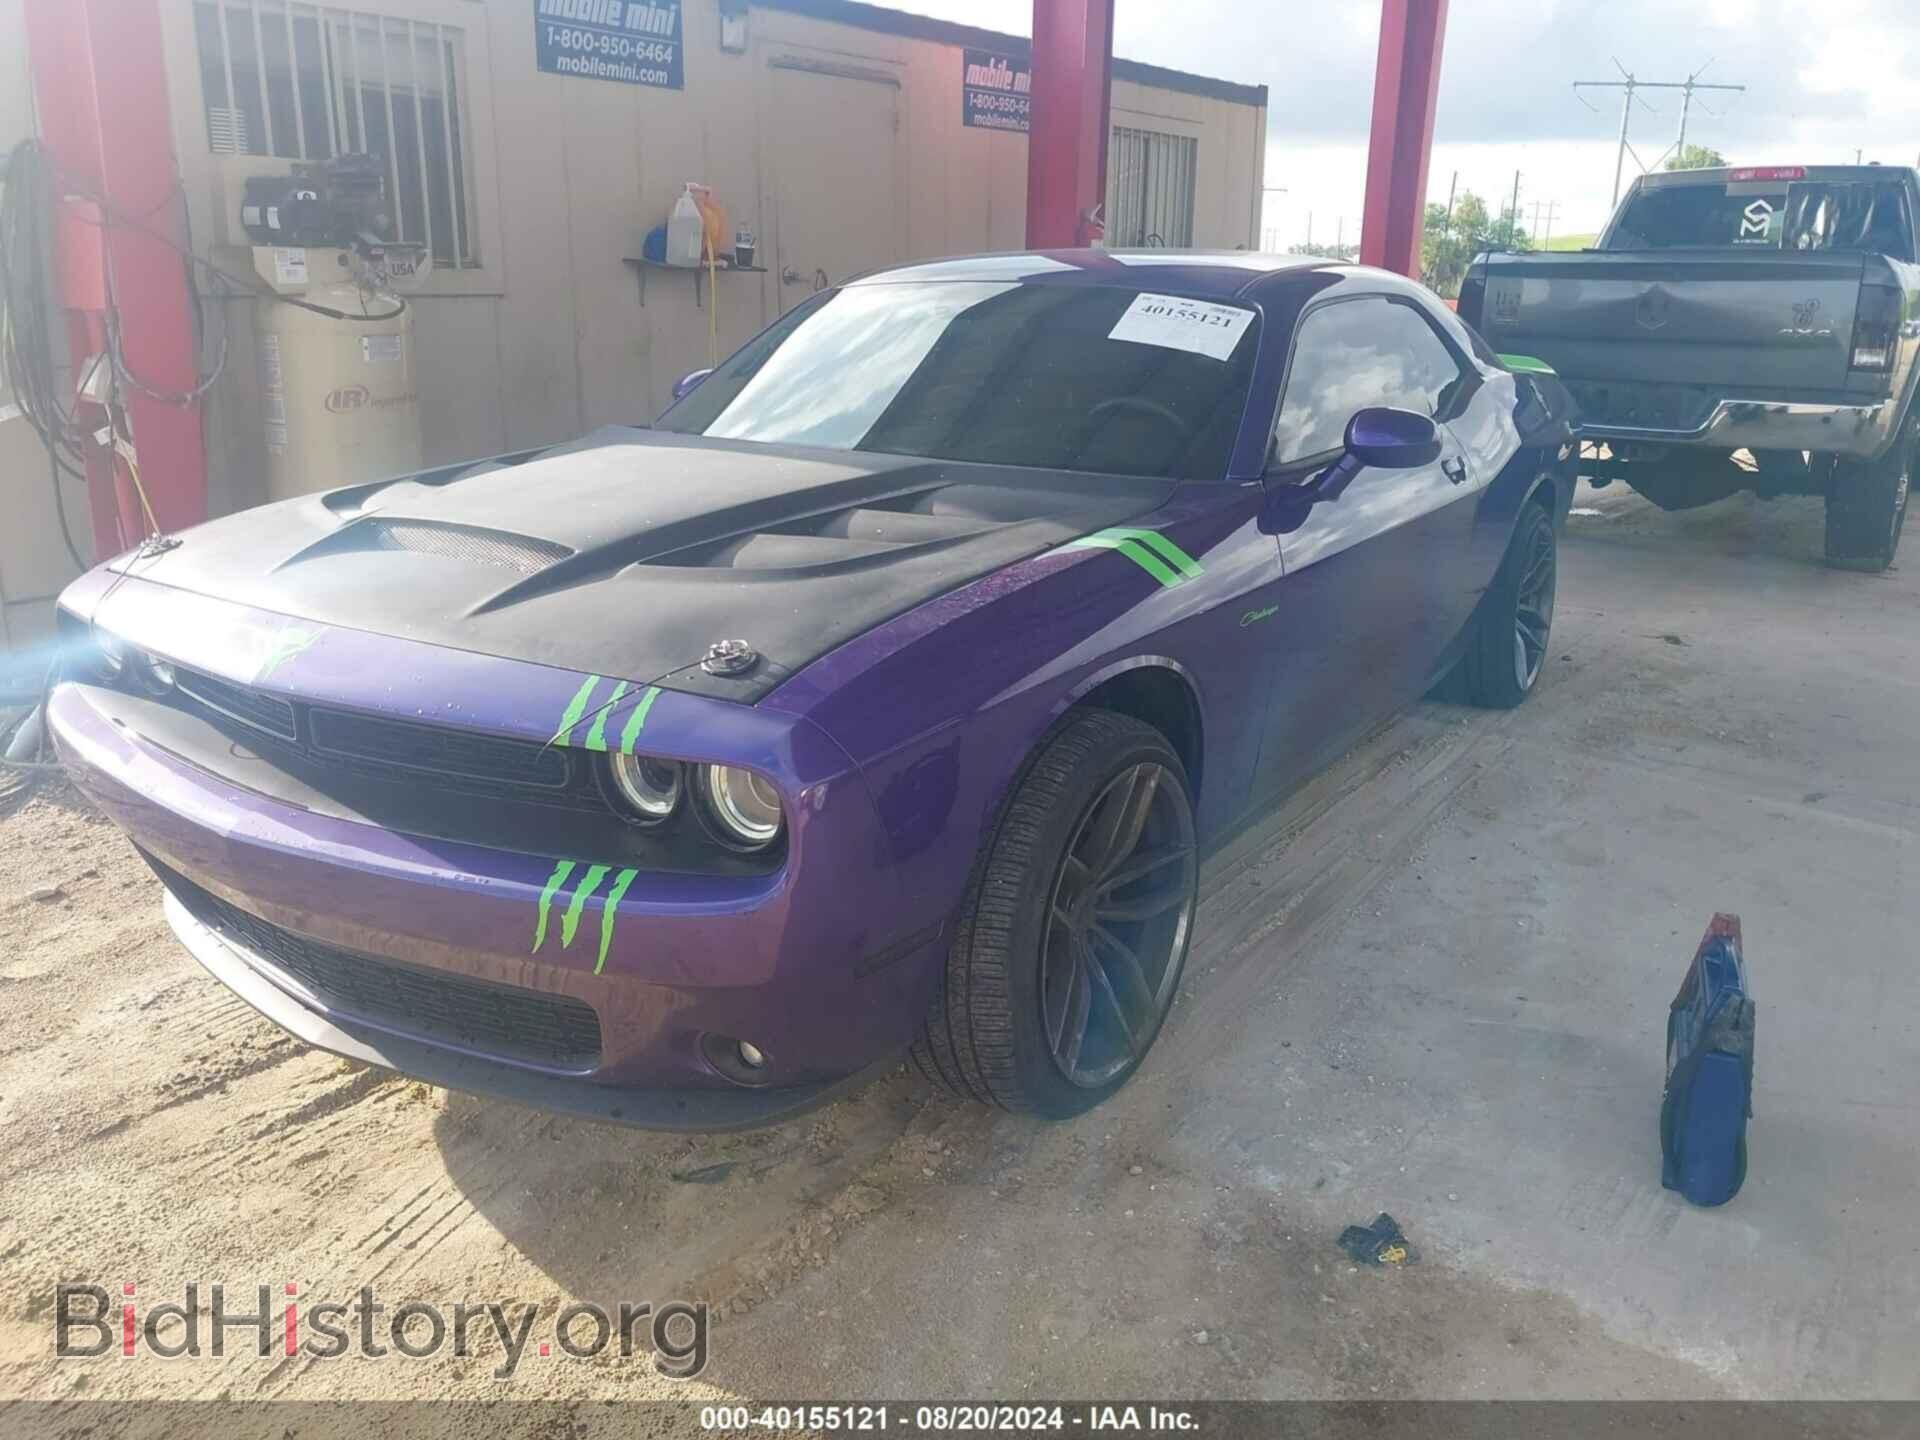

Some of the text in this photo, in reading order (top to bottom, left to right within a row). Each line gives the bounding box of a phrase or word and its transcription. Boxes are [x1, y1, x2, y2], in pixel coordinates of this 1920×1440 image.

[539, 0, 677, 36] mobile mini
[546, 27, 673, 63] 1-800-950-6464
[556, 55, 669, 84] mobilemini.com
[966, 57, 1032, 93] mobile mi
[969, 93, 1030, 115] 1-800-950-64
[974, 113, 1030, 131] mobilemini.co
[1141, 304, 1231, 328] 40155121
